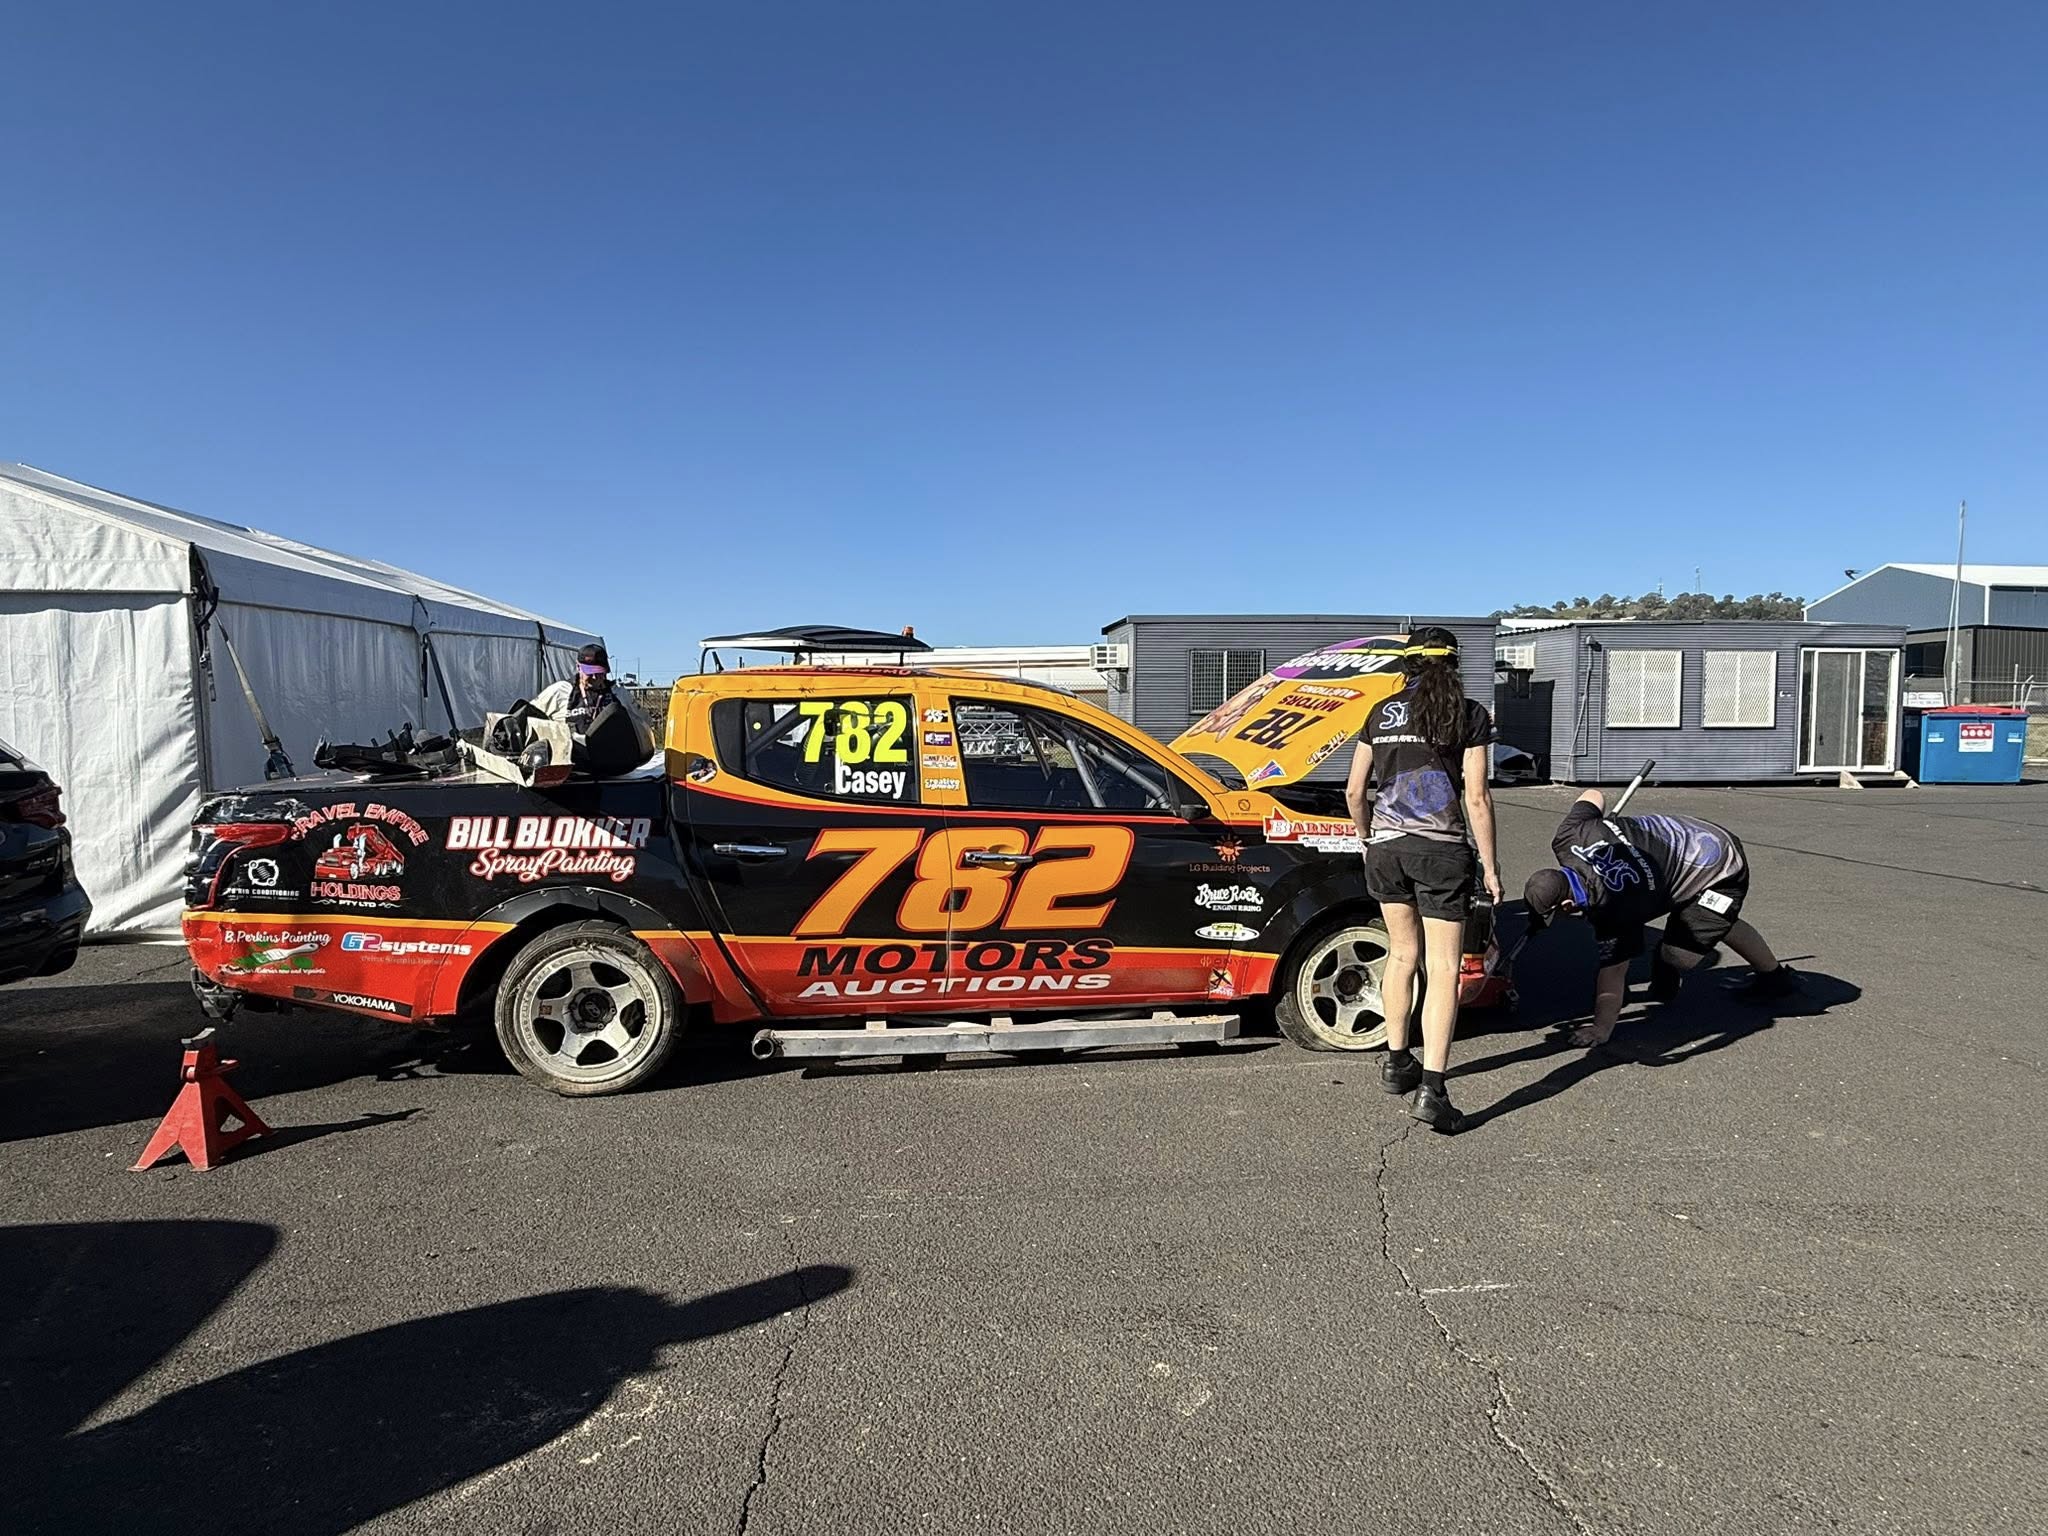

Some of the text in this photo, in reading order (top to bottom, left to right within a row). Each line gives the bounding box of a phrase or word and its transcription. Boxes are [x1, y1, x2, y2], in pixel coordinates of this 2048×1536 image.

[1278, 695, 1346, 712] MOTORS
[800, 701, 907, 763] 782
[1235, 708, 1326, 750] 782
[837, 765, 906, 799] Casey
[364, 803, 430, 847] EMPIRE
[446, 816, 652, 849] BILL BLOKKER
[1189, 863, 1271, 874] LG Building Projects
[311, 882, 401, 900] HOLDINGS
[790, 826, 1136, 936] 782
[338, 899, 357, 907] PTY
[1194, 883, 1264, 907] Bruce Rock
[237, 930, 280, 943] Perkins
[281, 930, 332, 947] Painting
[796, 938, 1115, 977] MOTORS
[797, 974, 1112, 998] AUCTIONS
[333, 993, 397, 1013] YOKOHAMA
